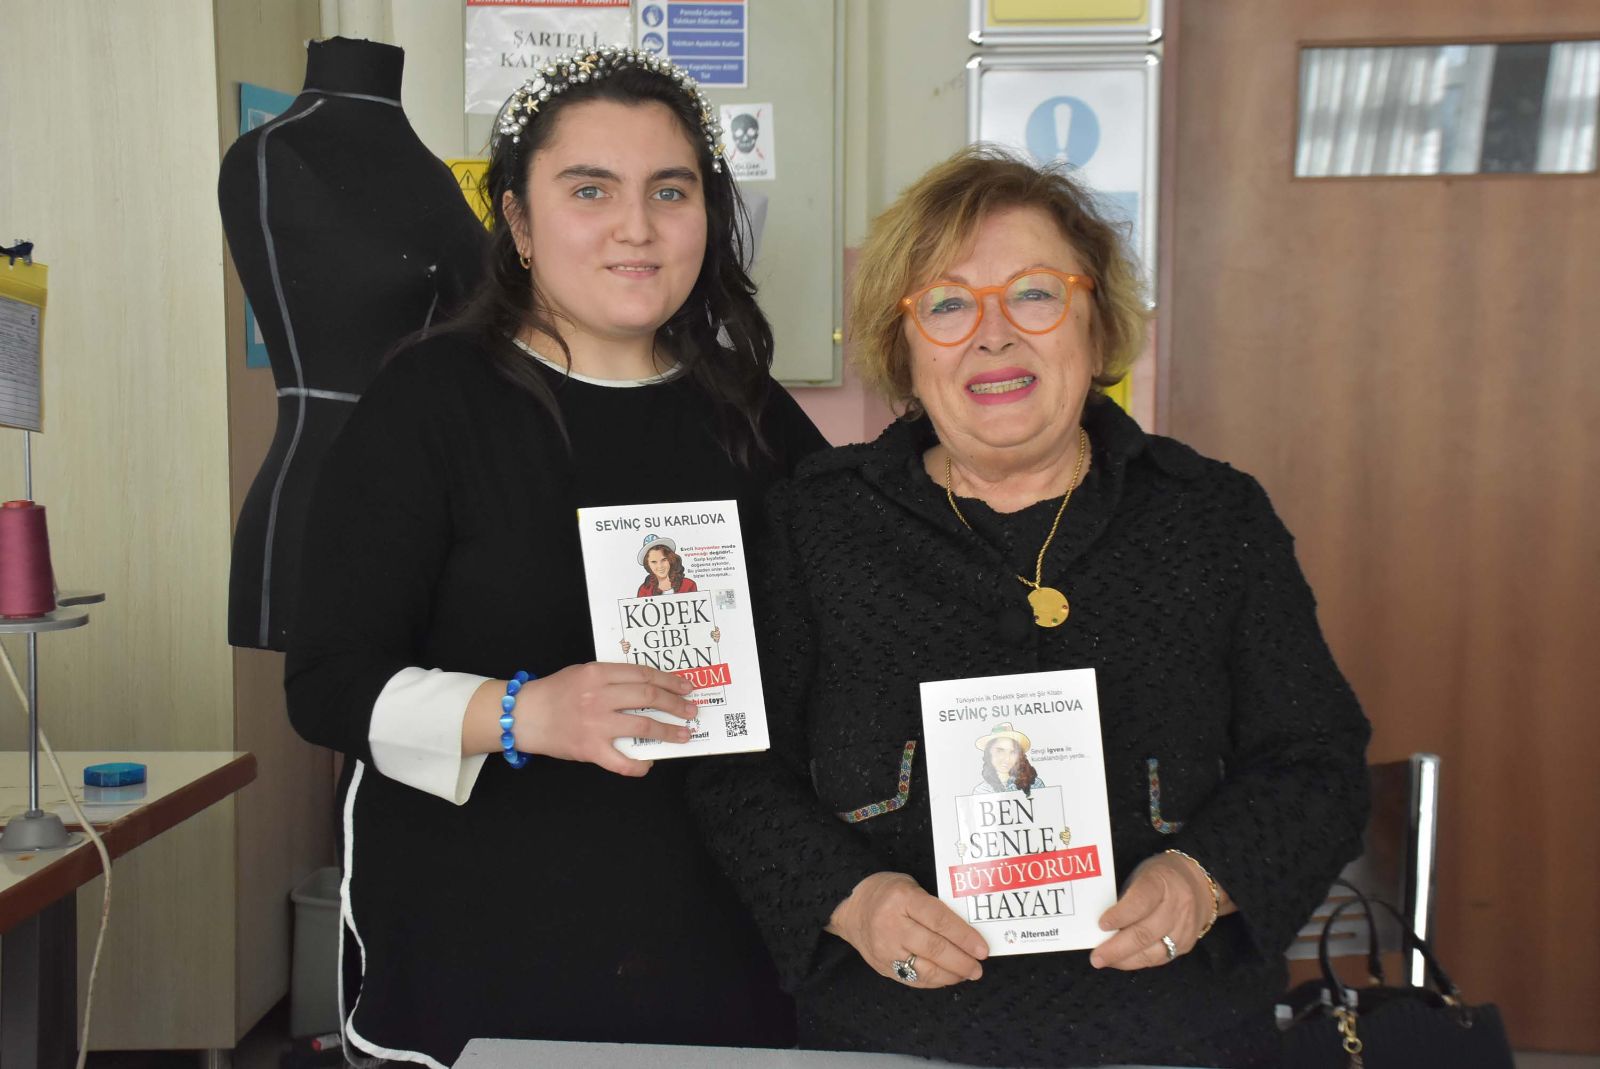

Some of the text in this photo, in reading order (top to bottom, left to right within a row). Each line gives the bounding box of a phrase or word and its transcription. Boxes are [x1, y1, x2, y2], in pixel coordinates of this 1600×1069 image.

[513, 30, 598, 48] ŞARTELİ
[501, 52, 552, 69] KAPA
[595, 513, 726, 532] SEVİNÇ SU KARLIOVA
[623, 598, 711, 629] KÖPEK
[643, 624, 691, 649] GİBİ
[632, 647, 712, 671] İNSAN
[677, 667, 728, 688] RUM
[939, 699, 1083, 722] SEVİNÇ SU KARLIOVA
[979, 797, 1034, 827] BEN
[970, 827, 1057, 859] SENLE
[953, 853, 1096, 892] BÜYÜYORUM
[973, 888, 1065, 920] HAYAT
[1021, 928, 1059, 938] Alternatif
